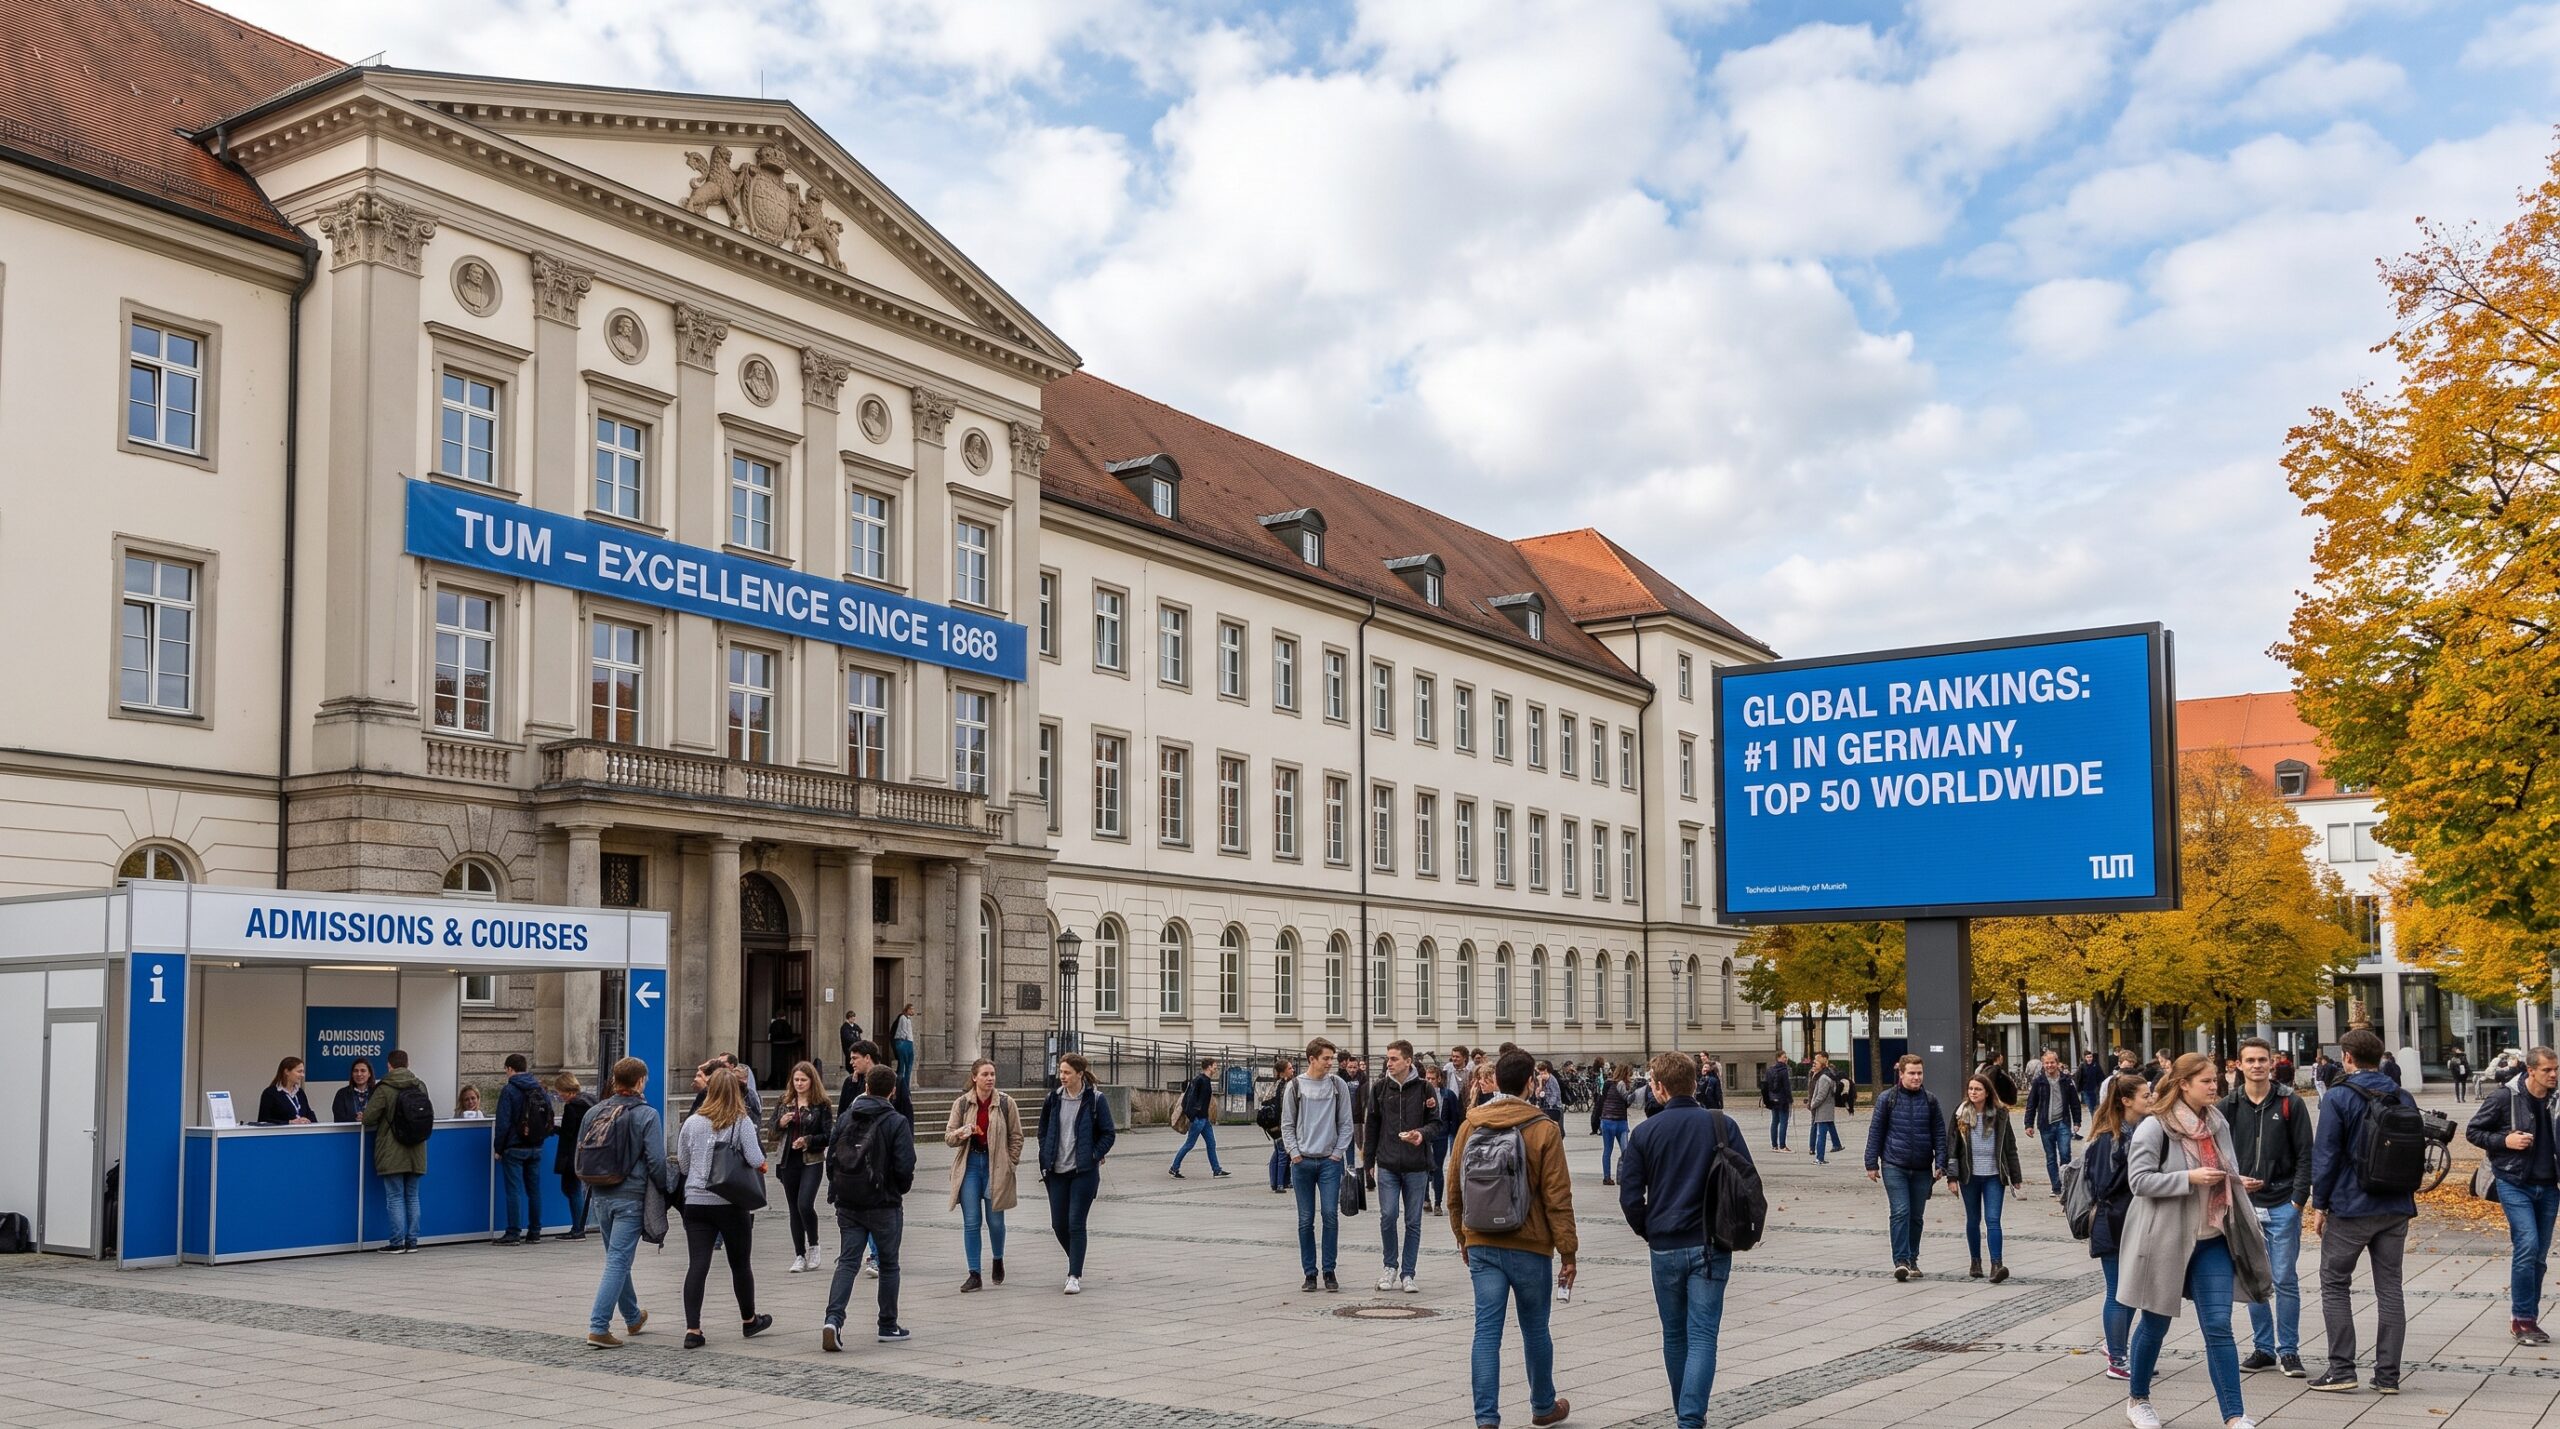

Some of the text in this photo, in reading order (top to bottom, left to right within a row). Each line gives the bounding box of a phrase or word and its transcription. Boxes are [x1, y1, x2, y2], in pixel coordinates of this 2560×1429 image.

[456, 507, 552, 566] TUM
[598, 541, 829, 626] EXCELLENCE
[838, 596, 929, 648] SINCE
[937, 621, 998, 662] 1868
[1743, 665, 2091, 728] GLOBAL RANKINGS:
[1743, 719, 2023, 773] #1 IN GERMANY,
[1743, 760, 2104, 817] TOP 50 WORLDWIDE
[1745, 885, 1777, 894] Technical
[1812, 883, 1820, 892] of
[1820, 882, 1848, 892] Munich
[2088, 853, 2134, 880] TUM
[245, 907, 588, 952] ADMISSIONS & COURSES
[318, 1029, 385, 1042] ADMISSIONS
[322, 1044, 381, 1057] & COURSES
